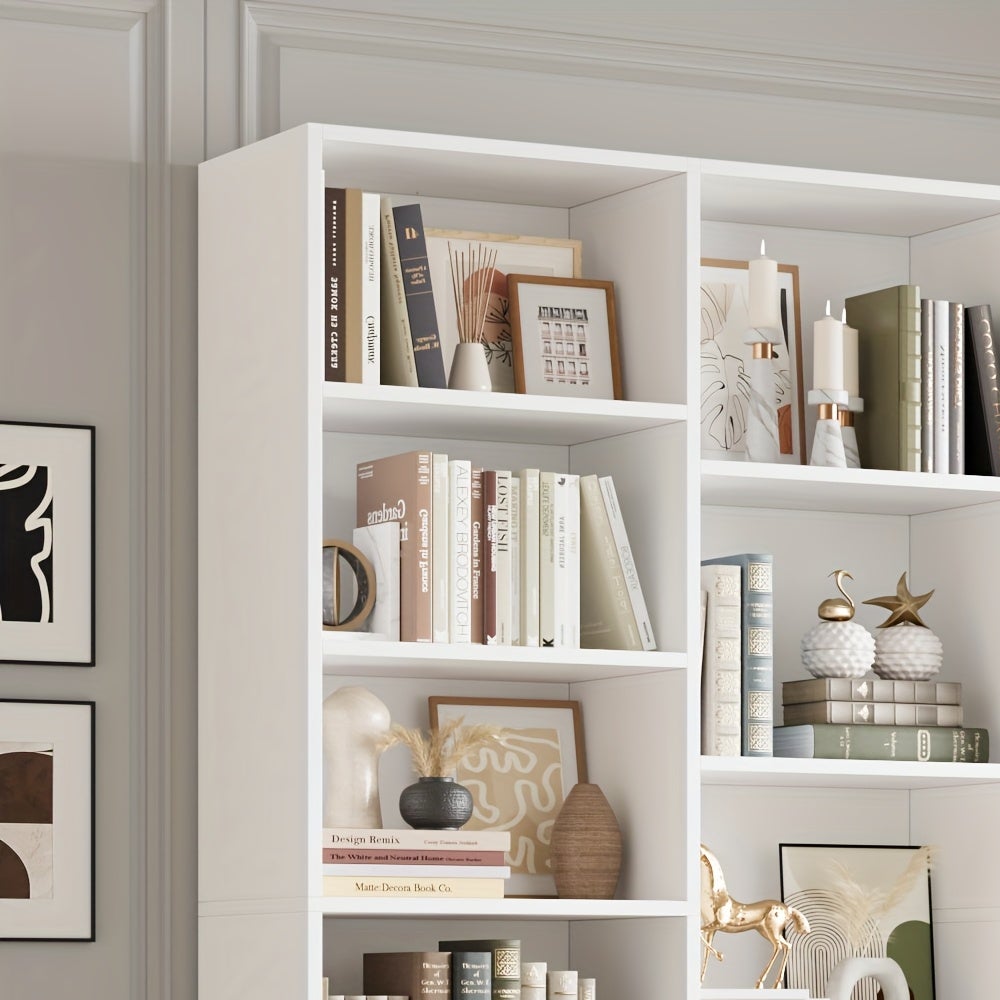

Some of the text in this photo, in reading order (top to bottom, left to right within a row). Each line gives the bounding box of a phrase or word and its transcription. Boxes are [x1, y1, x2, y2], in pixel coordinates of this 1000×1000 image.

[495, 476, 509, 553] LOST FISH
[454, 464, 468, 638] ALEXEY BRODOVITCH
[471, 521, 480, 599] Gardens in France
[330, 852, 345, 861] The
[346, 853, 372, 861] White
[390, 853, 419, 862] Neutral
[421, 854, 444, 862] Home
[331, 834, 401, 846] Design Remix
[355, 882, 453, 894] Matte Decora Book Co.
